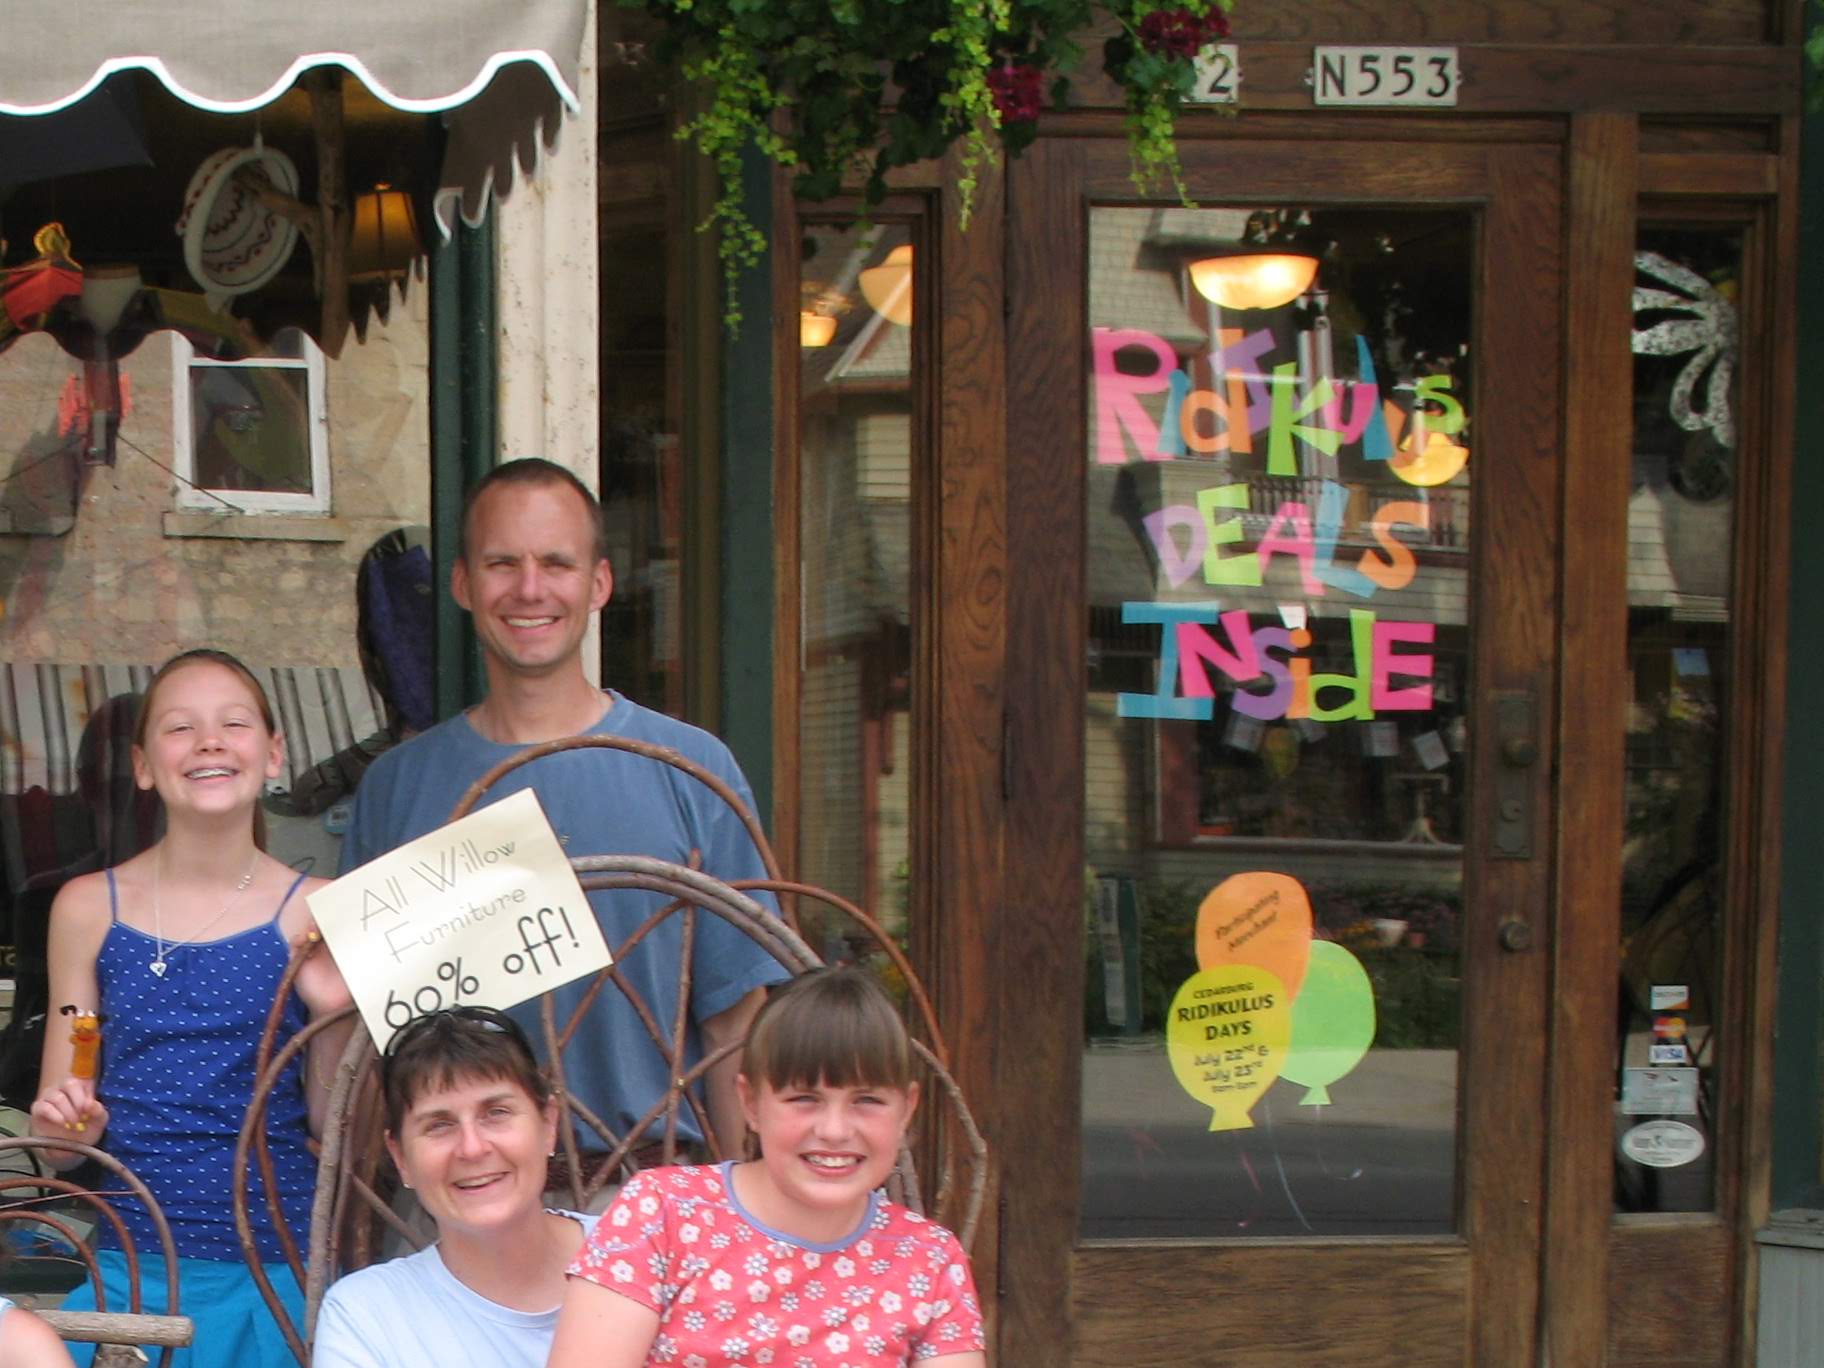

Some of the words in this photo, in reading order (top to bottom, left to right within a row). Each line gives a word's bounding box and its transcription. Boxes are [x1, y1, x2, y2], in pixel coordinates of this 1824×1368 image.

[1318, 54, 1451, 98] N553
[1142, 480, 1430, 598] DEALS
[359, 874, 411, 932] All
[409, 837, 518, 894] Willow
[383, 885, 528, 963] Furniture
[383, 956, 481, 1030] 60%
[502, 906, 581, 976] off!
[1177, 993, 1275, 1023] RIDIKULUS
[1204, 1020, 1253, 1042] DAYS
[1194, 1054, 1221, 1068] July
[1203, 1068, 1230, 1083] July
